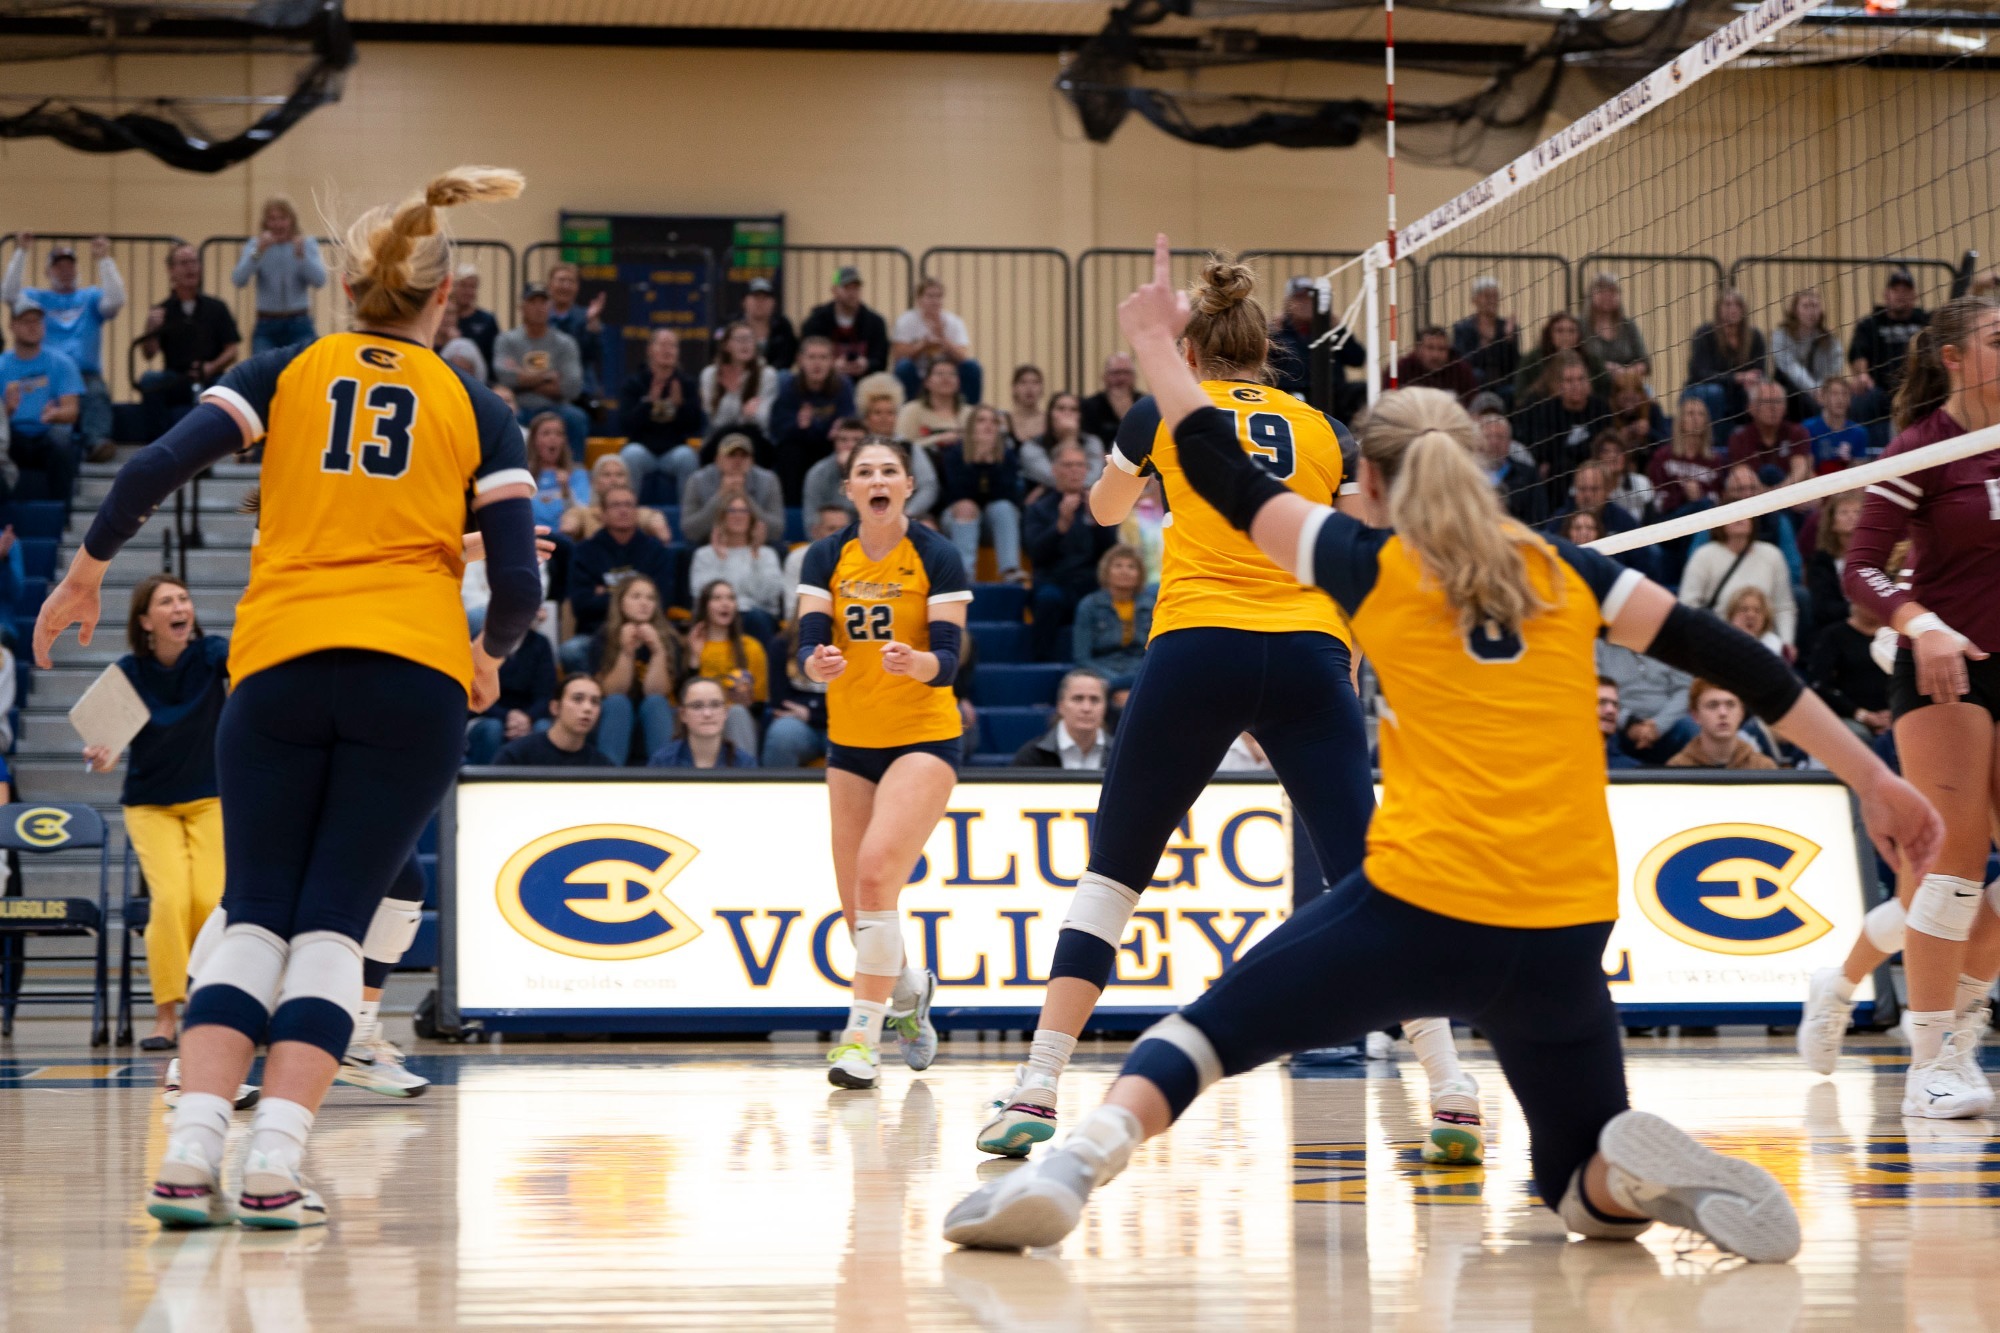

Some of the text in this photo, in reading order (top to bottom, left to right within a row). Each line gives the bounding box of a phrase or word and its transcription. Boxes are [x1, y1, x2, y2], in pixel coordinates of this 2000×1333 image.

[321, 376, 418, 480] 13
[1215, 407, 1297, 481] 9
[844, 603, 894, 642] 22
[526, 975, 678, 992] blugoldscom
